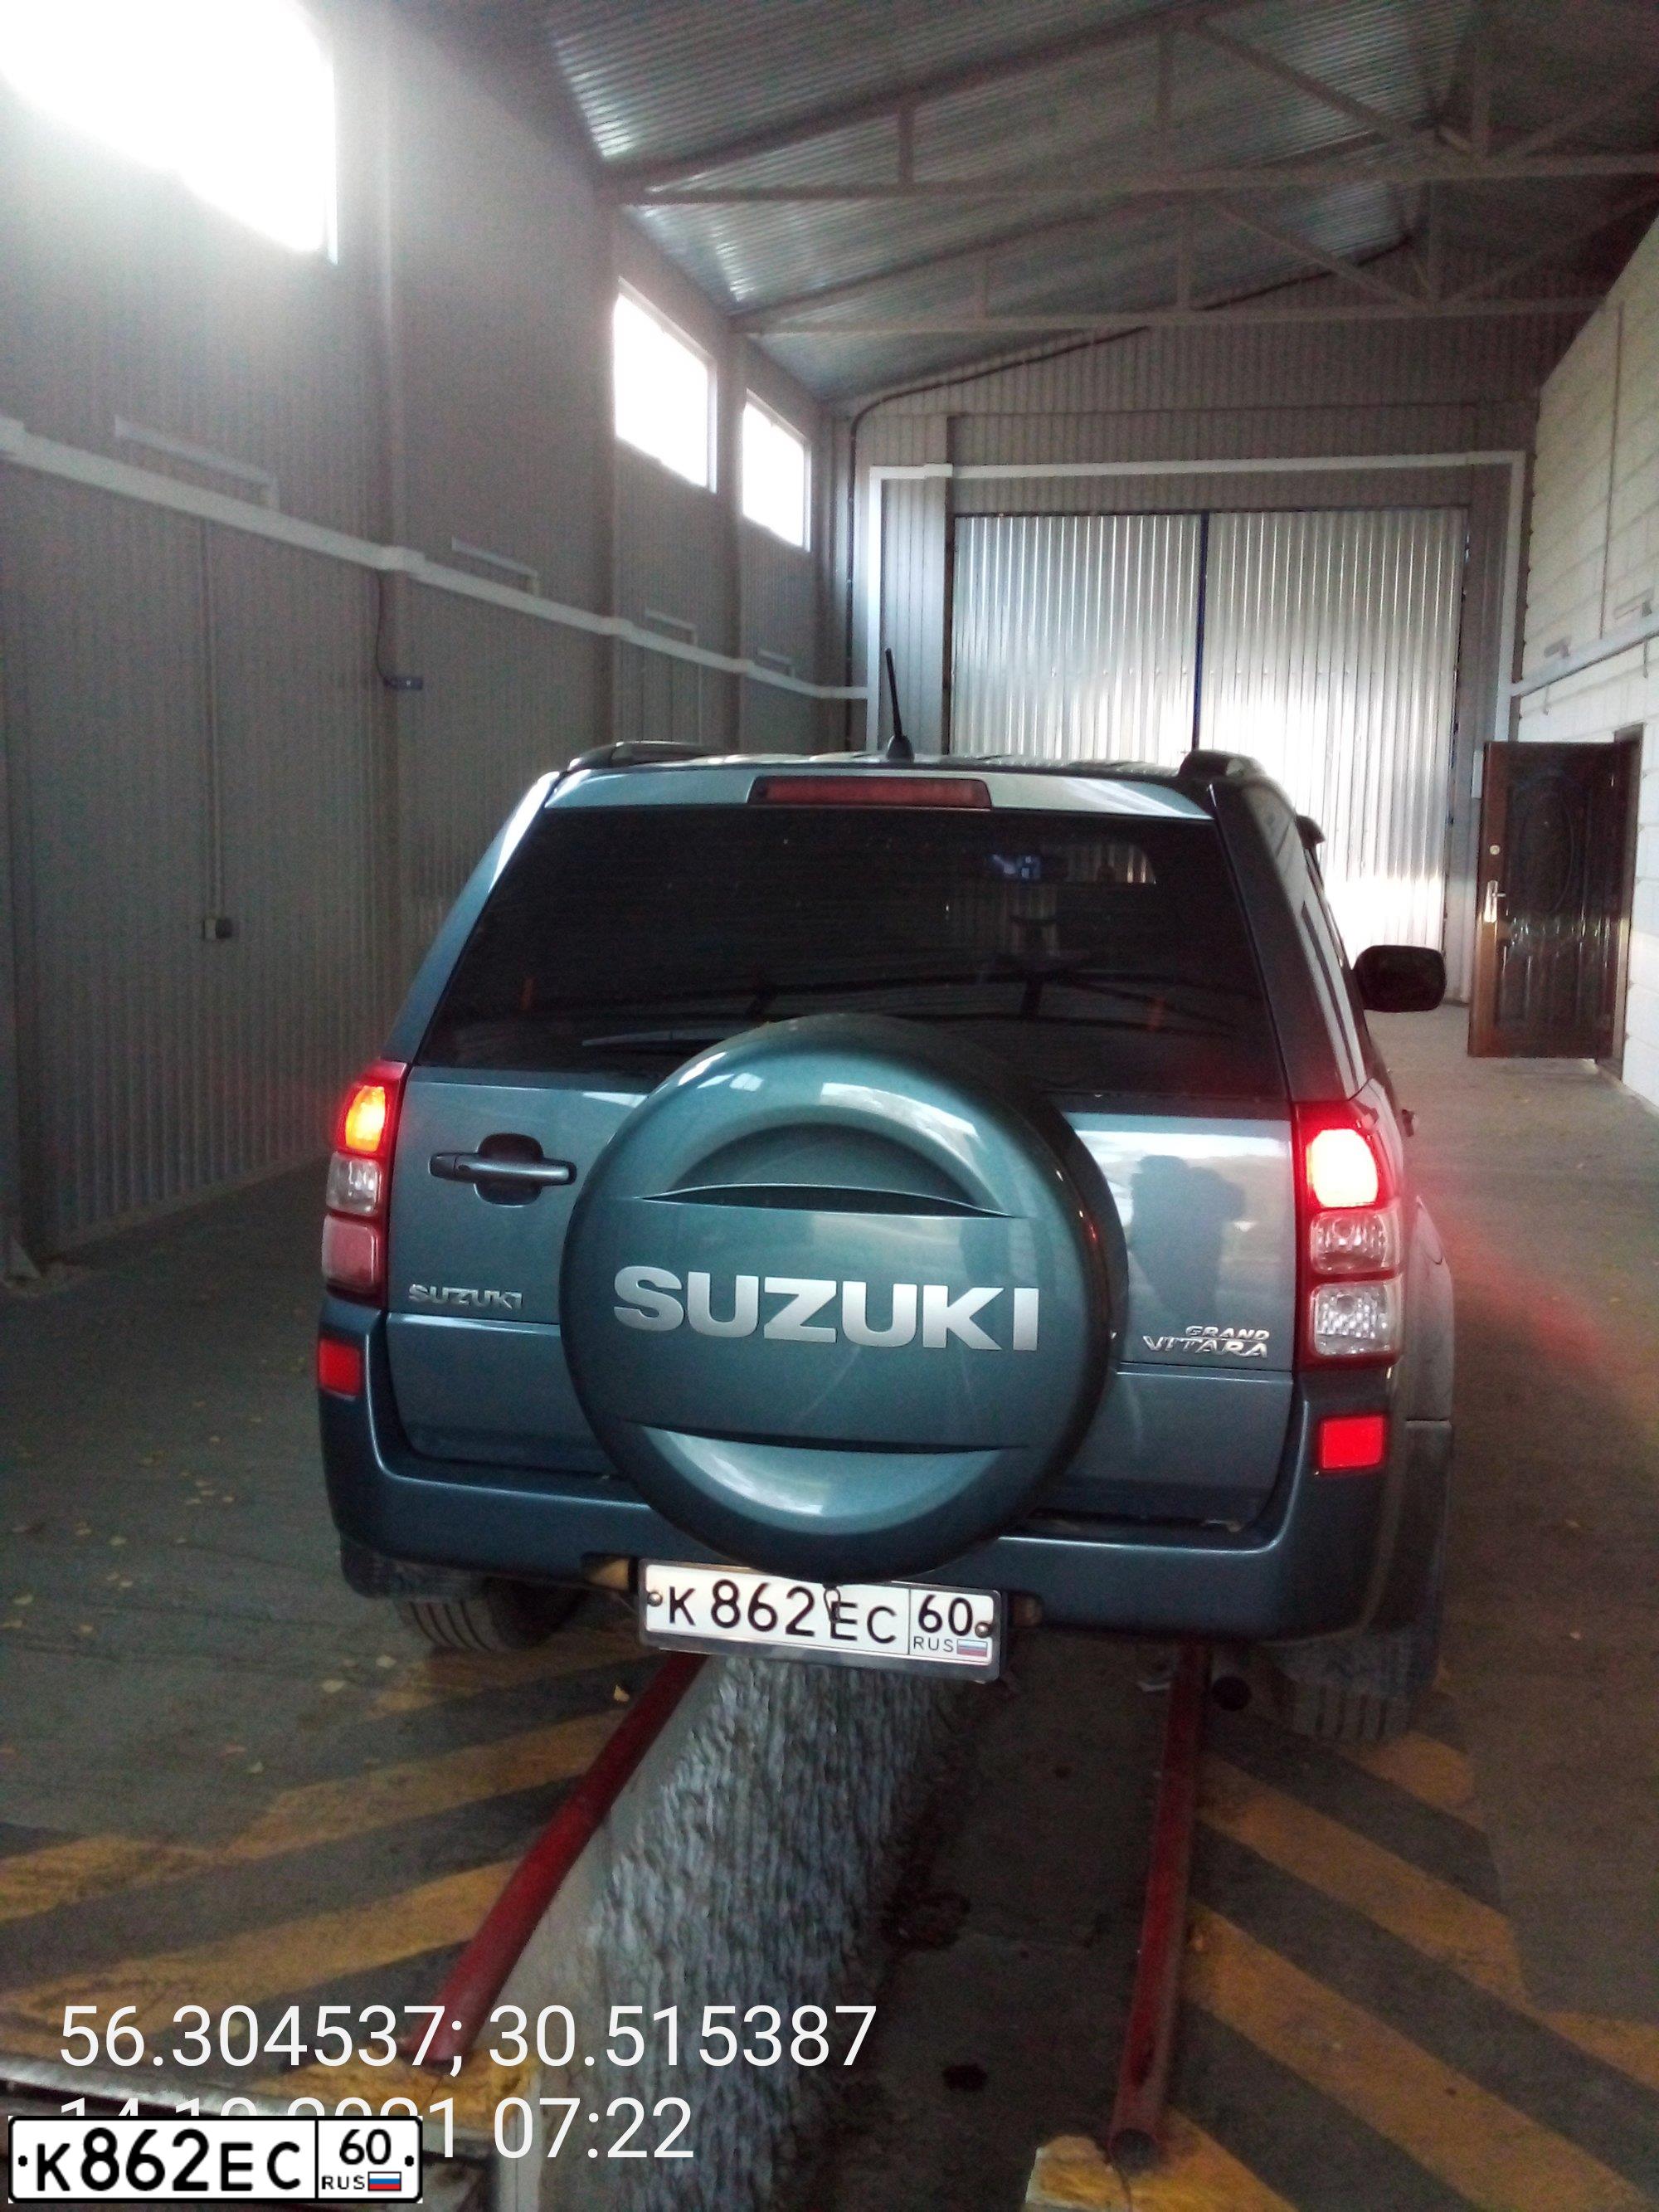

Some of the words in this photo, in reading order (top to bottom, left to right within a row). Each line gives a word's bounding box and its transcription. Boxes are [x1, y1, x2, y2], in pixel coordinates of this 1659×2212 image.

[408, 1284, 523, 1310] SUZUKI
[613, 1265, 1039, 1352] SUZUKI
[1185, 1325, 1270, 1341] GRAND
[1142, 1335, 1267, 1358] VITARA
[917, 1594, 974, 1638] 60
[912, 1635, 954, 1654] RUS
